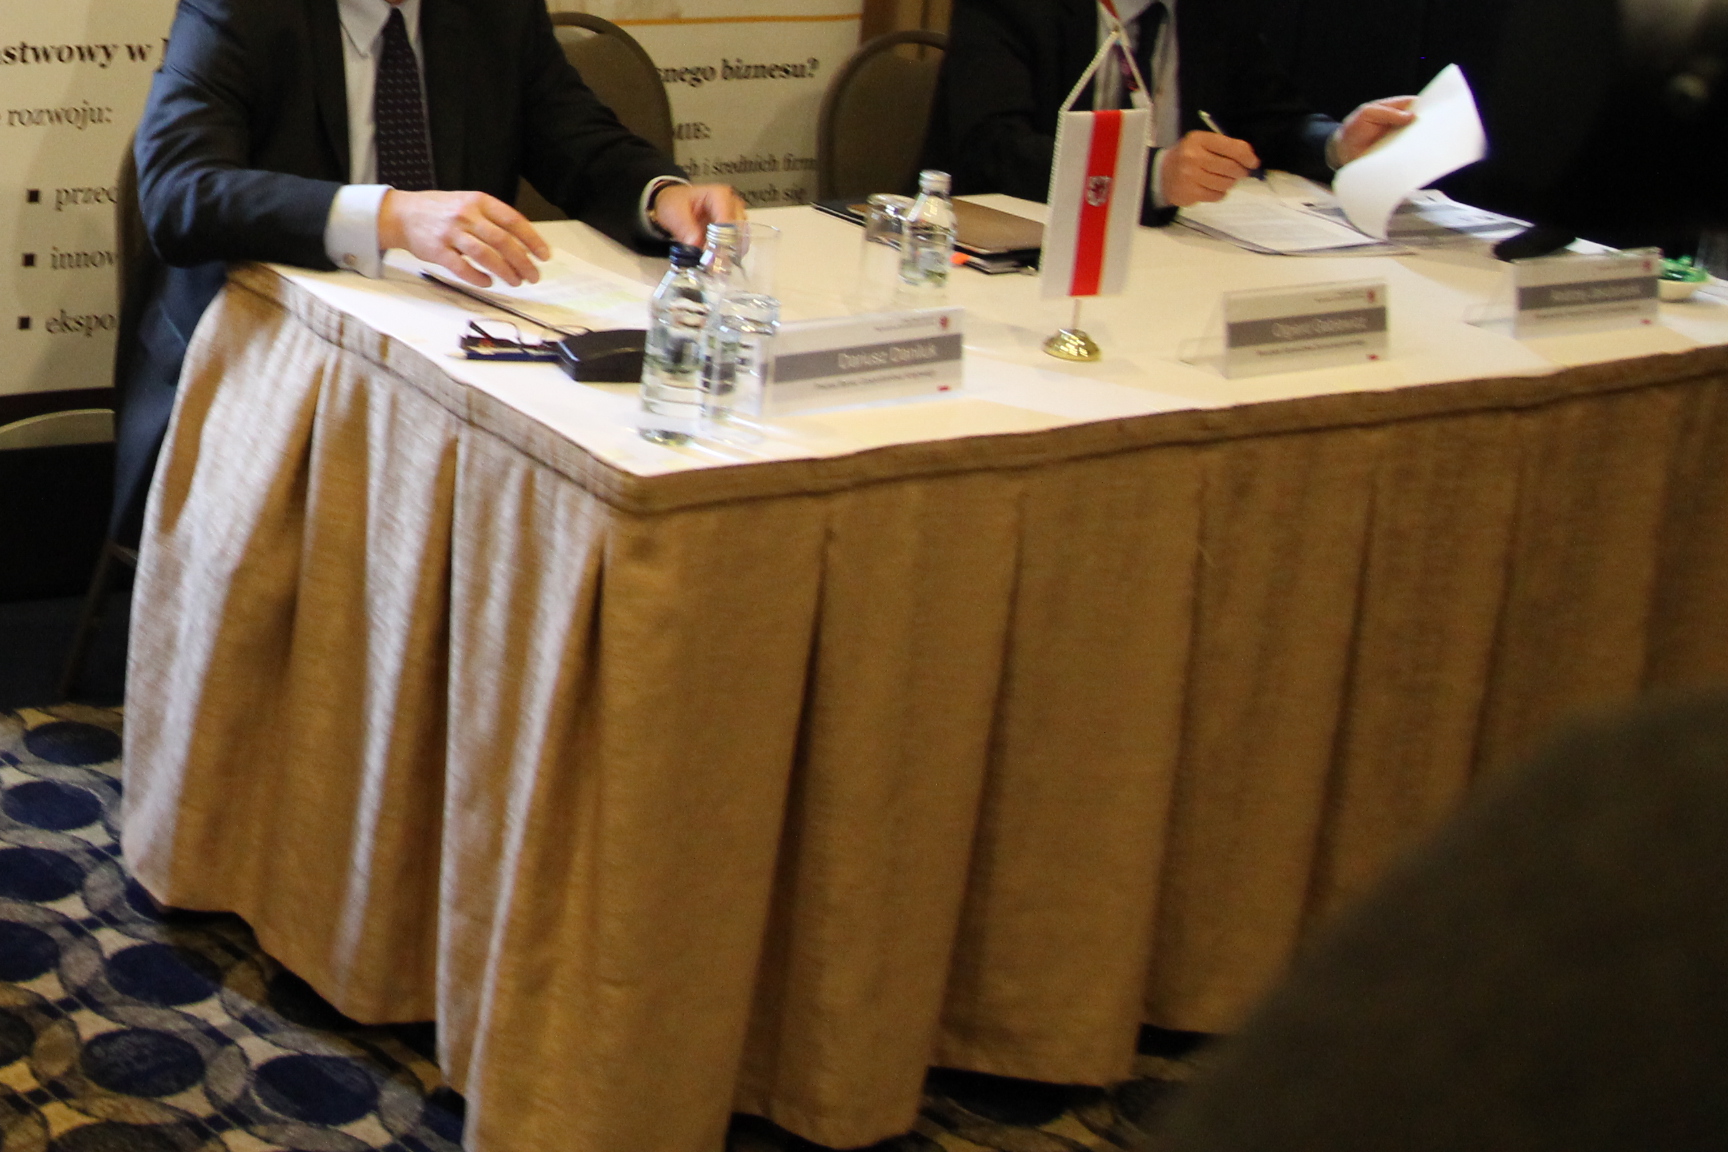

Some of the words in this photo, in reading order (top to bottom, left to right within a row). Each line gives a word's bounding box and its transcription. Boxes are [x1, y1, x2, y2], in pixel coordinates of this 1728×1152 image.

[124, 44, 152, 62] w
[721, 56, 820, 81] biznesu?
[7, 100, 113, 130] rozwoju:
